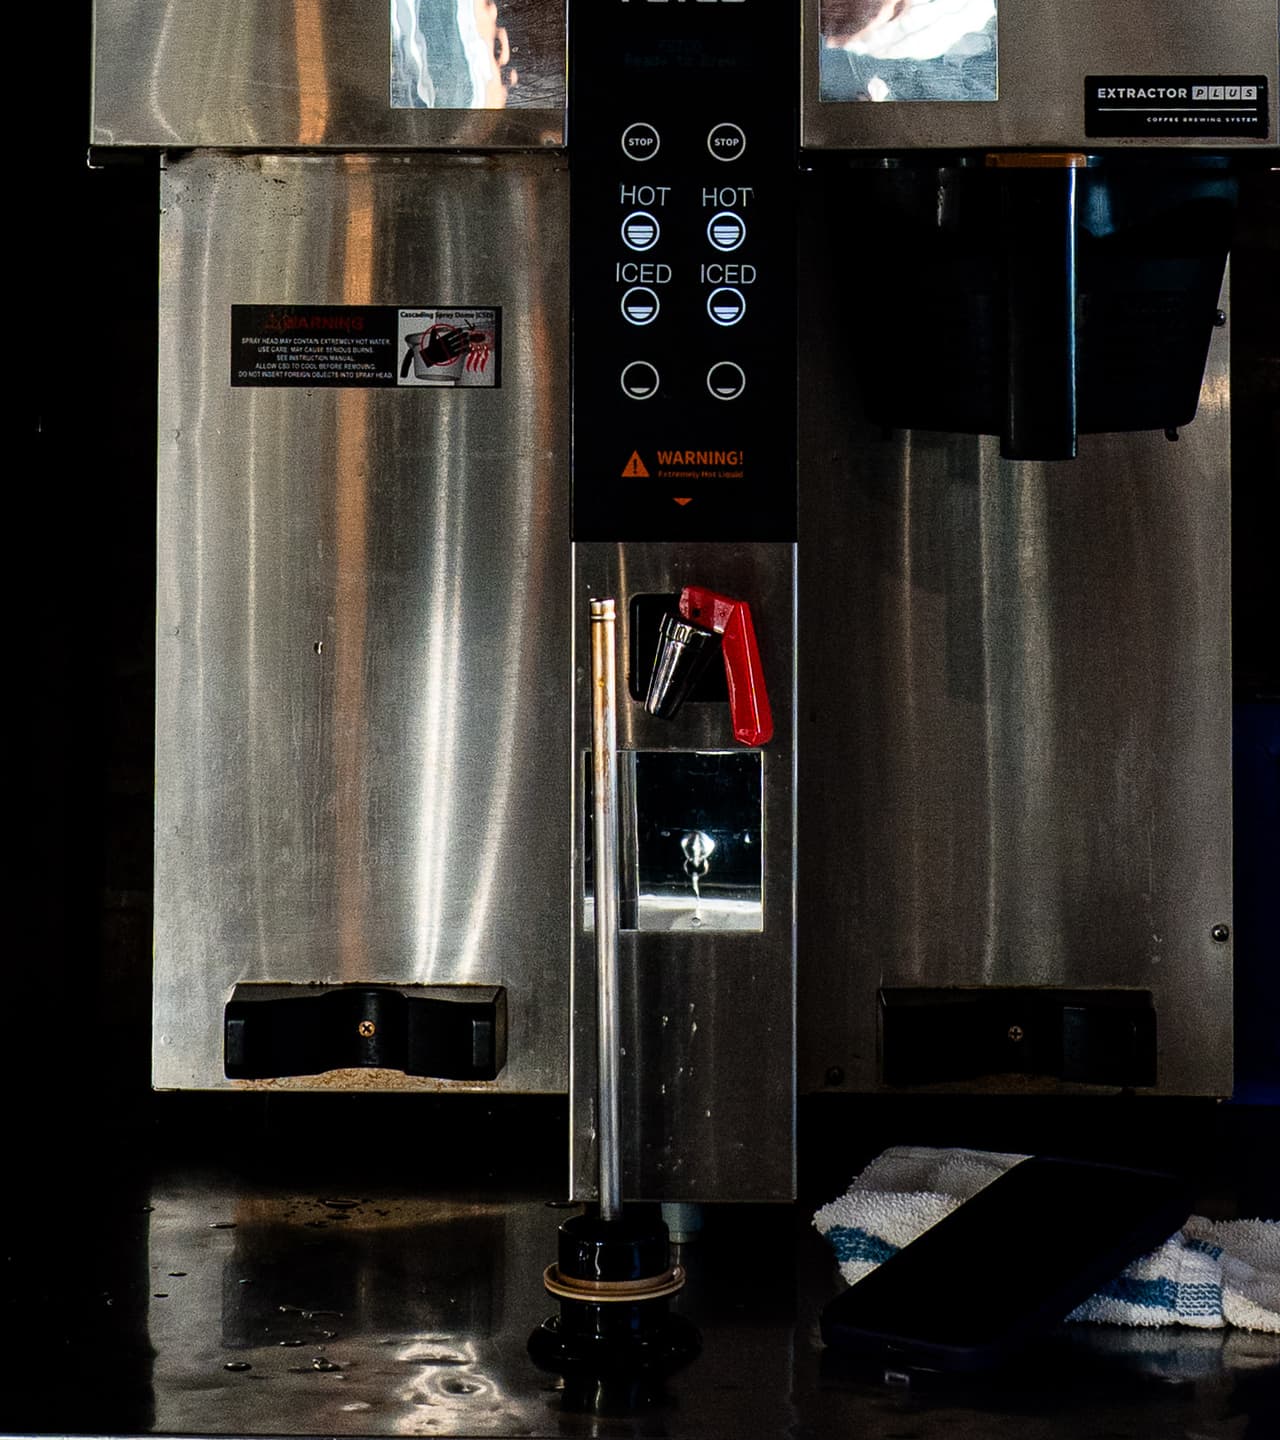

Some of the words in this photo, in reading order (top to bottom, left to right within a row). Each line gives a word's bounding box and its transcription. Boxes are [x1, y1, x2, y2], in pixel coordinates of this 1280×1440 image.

[1097, 88, 1188, 99] EXTRACTOR
[1192, 85, 1257, 100] PLUS
[627, 137, 654, 147] STOP
[714, 137, 740, 147] STOP
[620, 185, 672, 207] HOT
[702, 186, 752, 208] HOT
[615, 262, 673, 284] ICED
[700, 263, 757, 284] ICED
[656, 450, 745, 466] WARNING!
[701, 469, 717, 479] Hot
